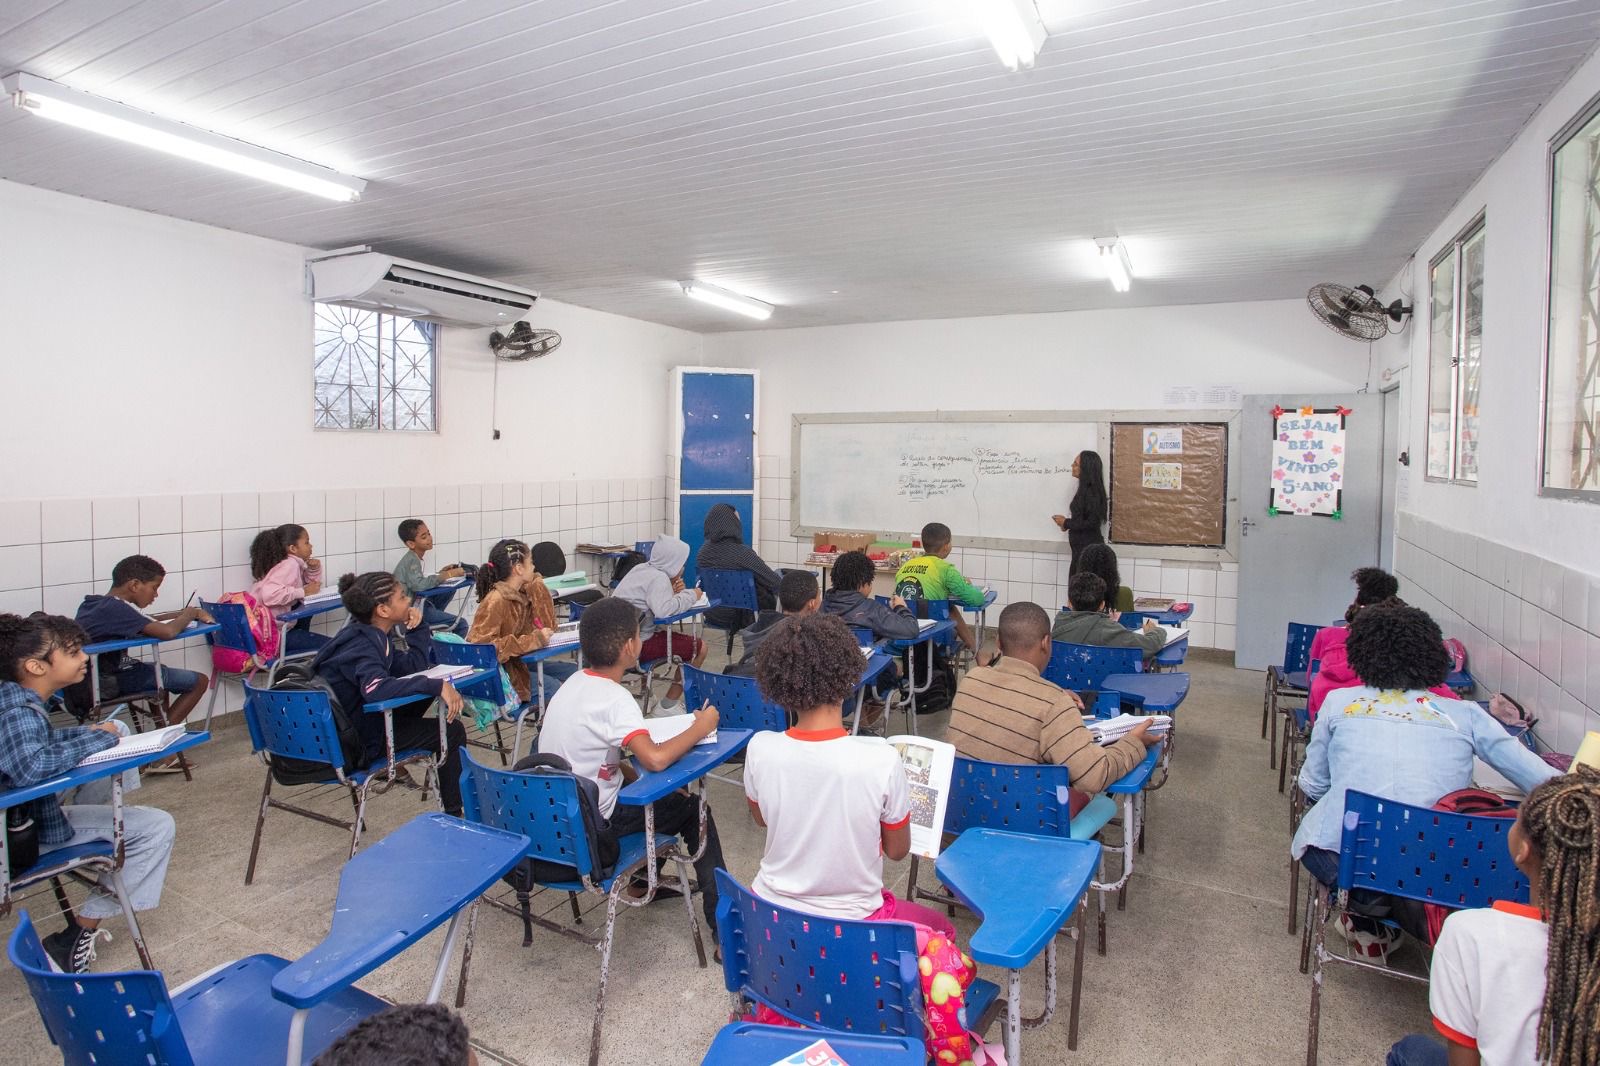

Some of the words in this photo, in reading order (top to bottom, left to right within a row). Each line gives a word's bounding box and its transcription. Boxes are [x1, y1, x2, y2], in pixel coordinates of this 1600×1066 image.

[1280, 419, 1338, 433] SEJAM
[1159, 441, 1181, 450] AUTISMO
[1288, 440, 1324, 450] BEM
[1278, 456, 1338, 474] VINDOS
[1301, 482, 1334, 492] ANO
